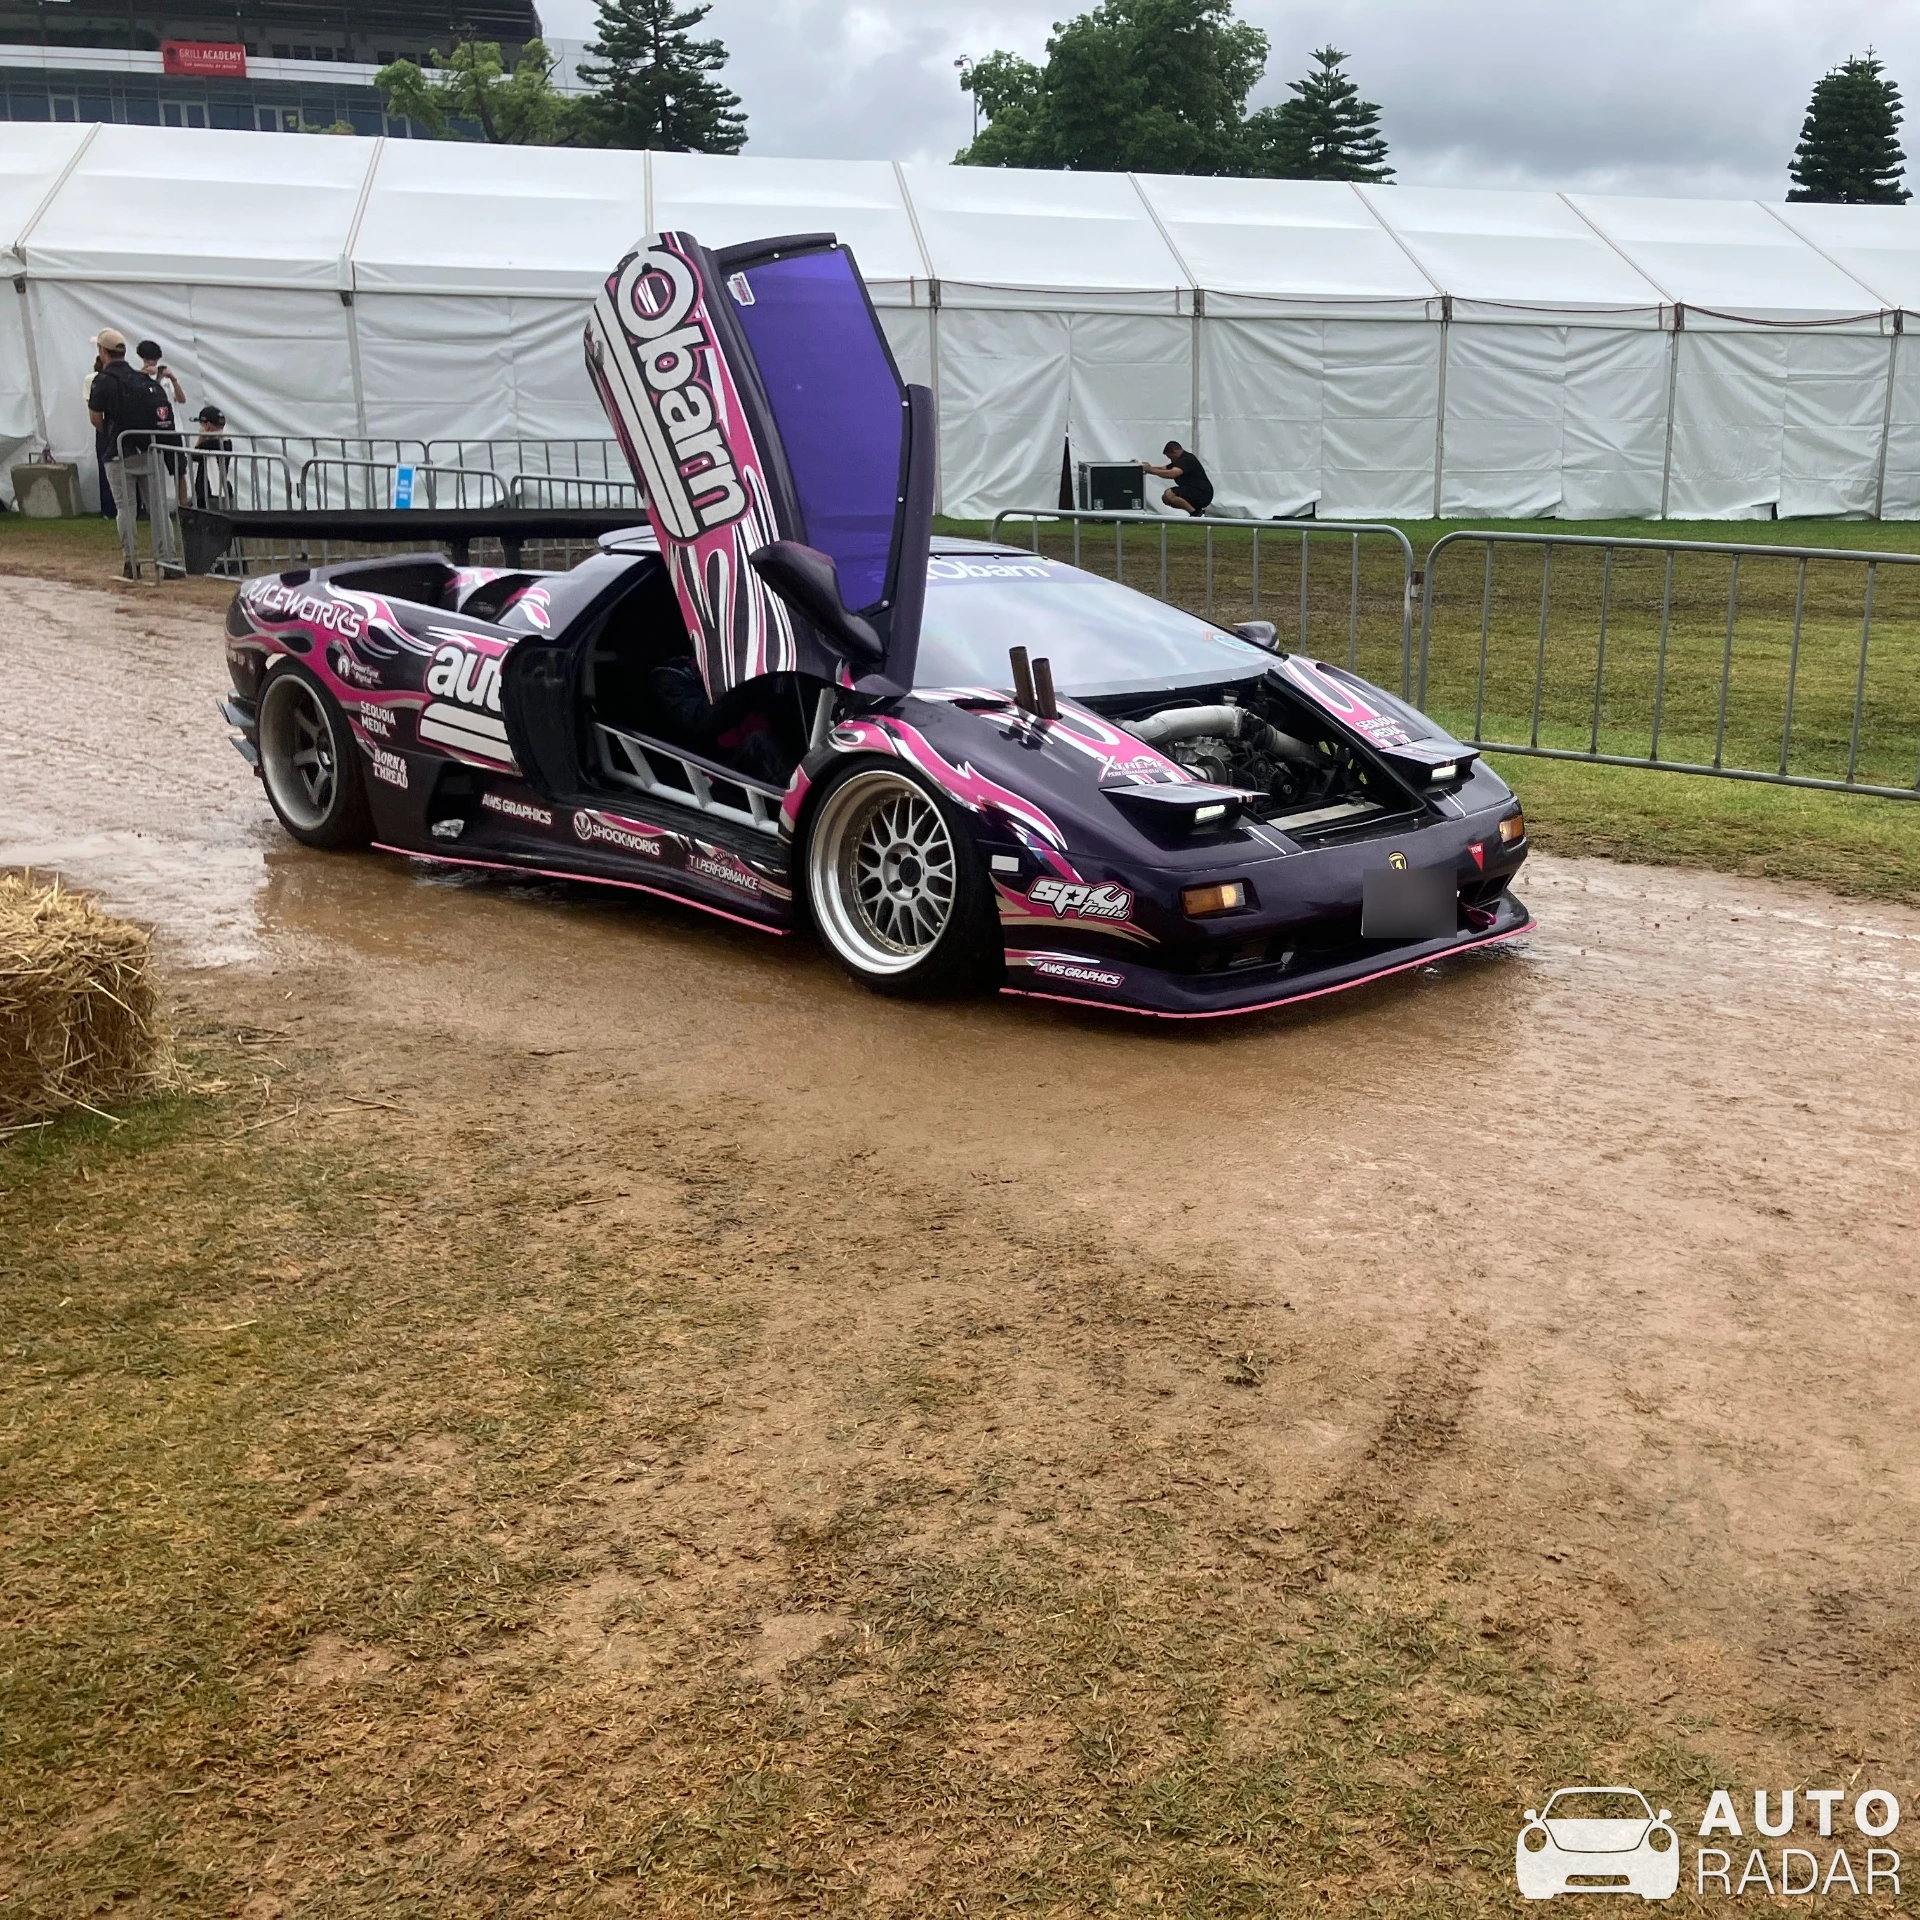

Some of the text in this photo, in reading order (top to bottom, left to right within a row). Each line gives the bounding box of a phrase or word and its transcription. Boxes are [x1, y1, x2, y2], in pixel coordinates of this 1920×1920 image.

[179, 48, 242, 61] GRILL ACADEMY
[246, 579, 365, 639] RACEWORKS
[360, 700, 397, 726] SEQUOIA
[373, 762, 409, 790] THREAD
[374, 748, 408, 777] BORN &
[1096, 755, 1164, 783] XTREME
[482, 793, 552, 825] AWS GRAPHICS
[592, 824, 660, 857] SHOCKWORKS
[1079, 899, 1129, 918] tools
[1038, 962, 1120, 985] AWS GRAPHICS
